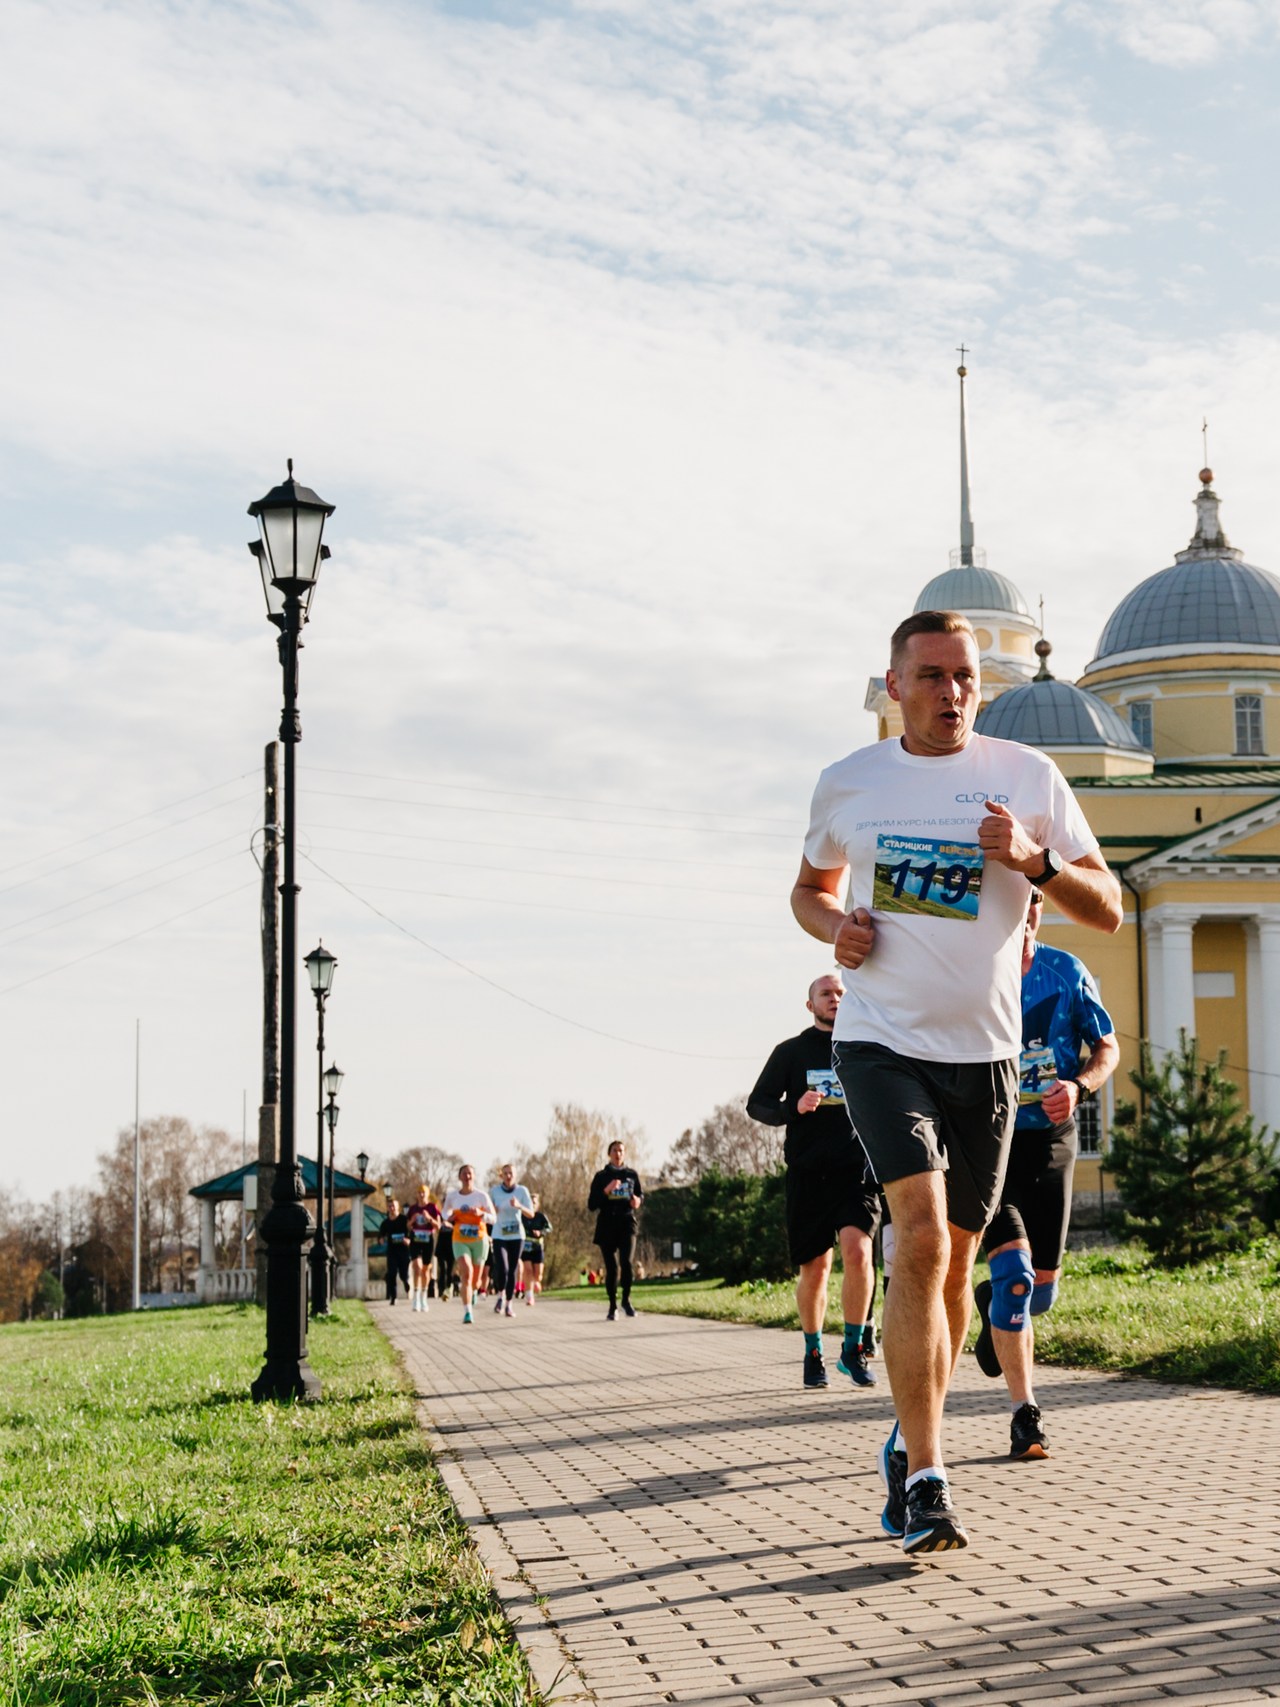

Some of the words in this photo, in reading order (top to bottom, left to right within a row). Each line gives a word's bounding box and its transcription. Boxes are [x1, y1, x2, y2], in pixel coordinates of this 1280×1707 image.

[955, 791, 1009, 804] CLOUD
[855, 818, 895, 832] ДЕРЖИМ
[896, 818, 923, 827] КУРС
[923, 818, 937, 826] НА
[938, 817, 982, 826] БЕЗОПАС
[883, 839, 933, 853] СТАРИЦКИЕ
[939, 844, 979, 857] ВЕРСТЫ
[889, 858, 971, 905] 119
[1021, 1063, 1041, 1092] 4
